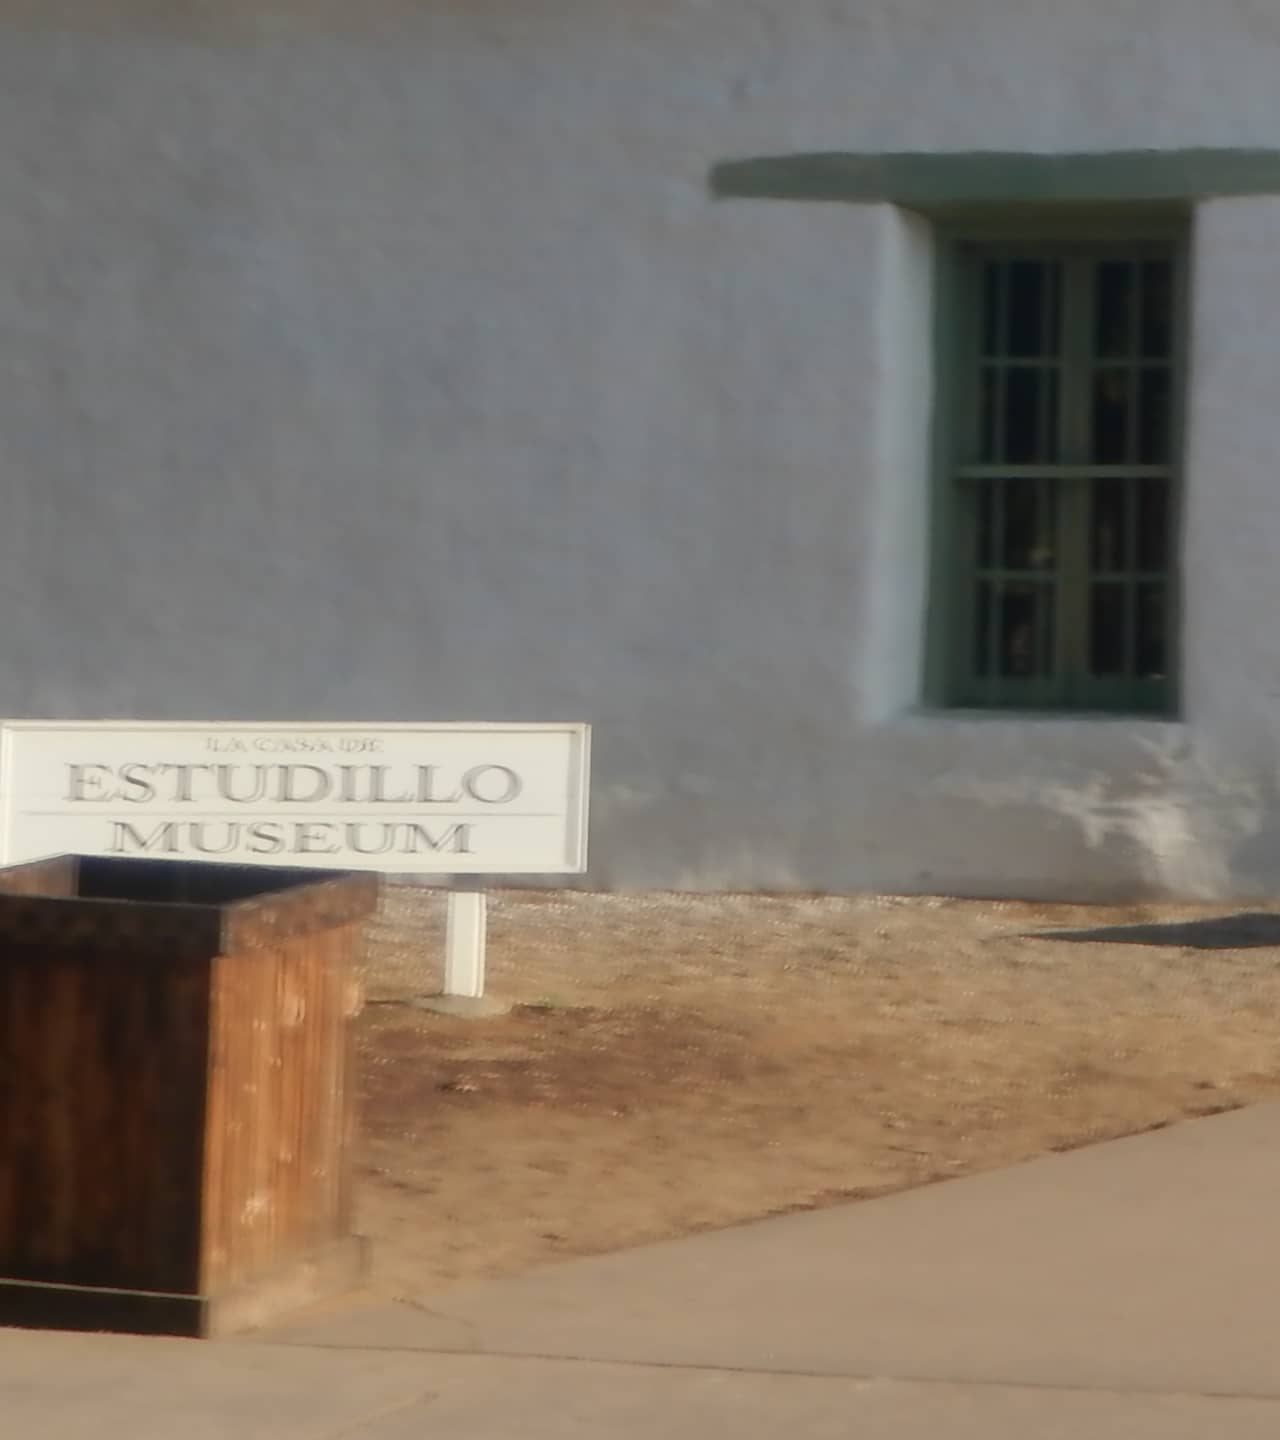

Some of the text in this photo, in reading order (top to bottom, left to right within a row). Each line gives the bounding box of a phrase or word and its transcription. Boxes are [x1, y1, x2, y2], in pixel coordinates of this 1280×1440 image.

[207, 736, 384, 753] LA CASA DE
[64, 763, 523, 804] ESTUDILLO
[105, 821, 477, 855] MUSEUM
